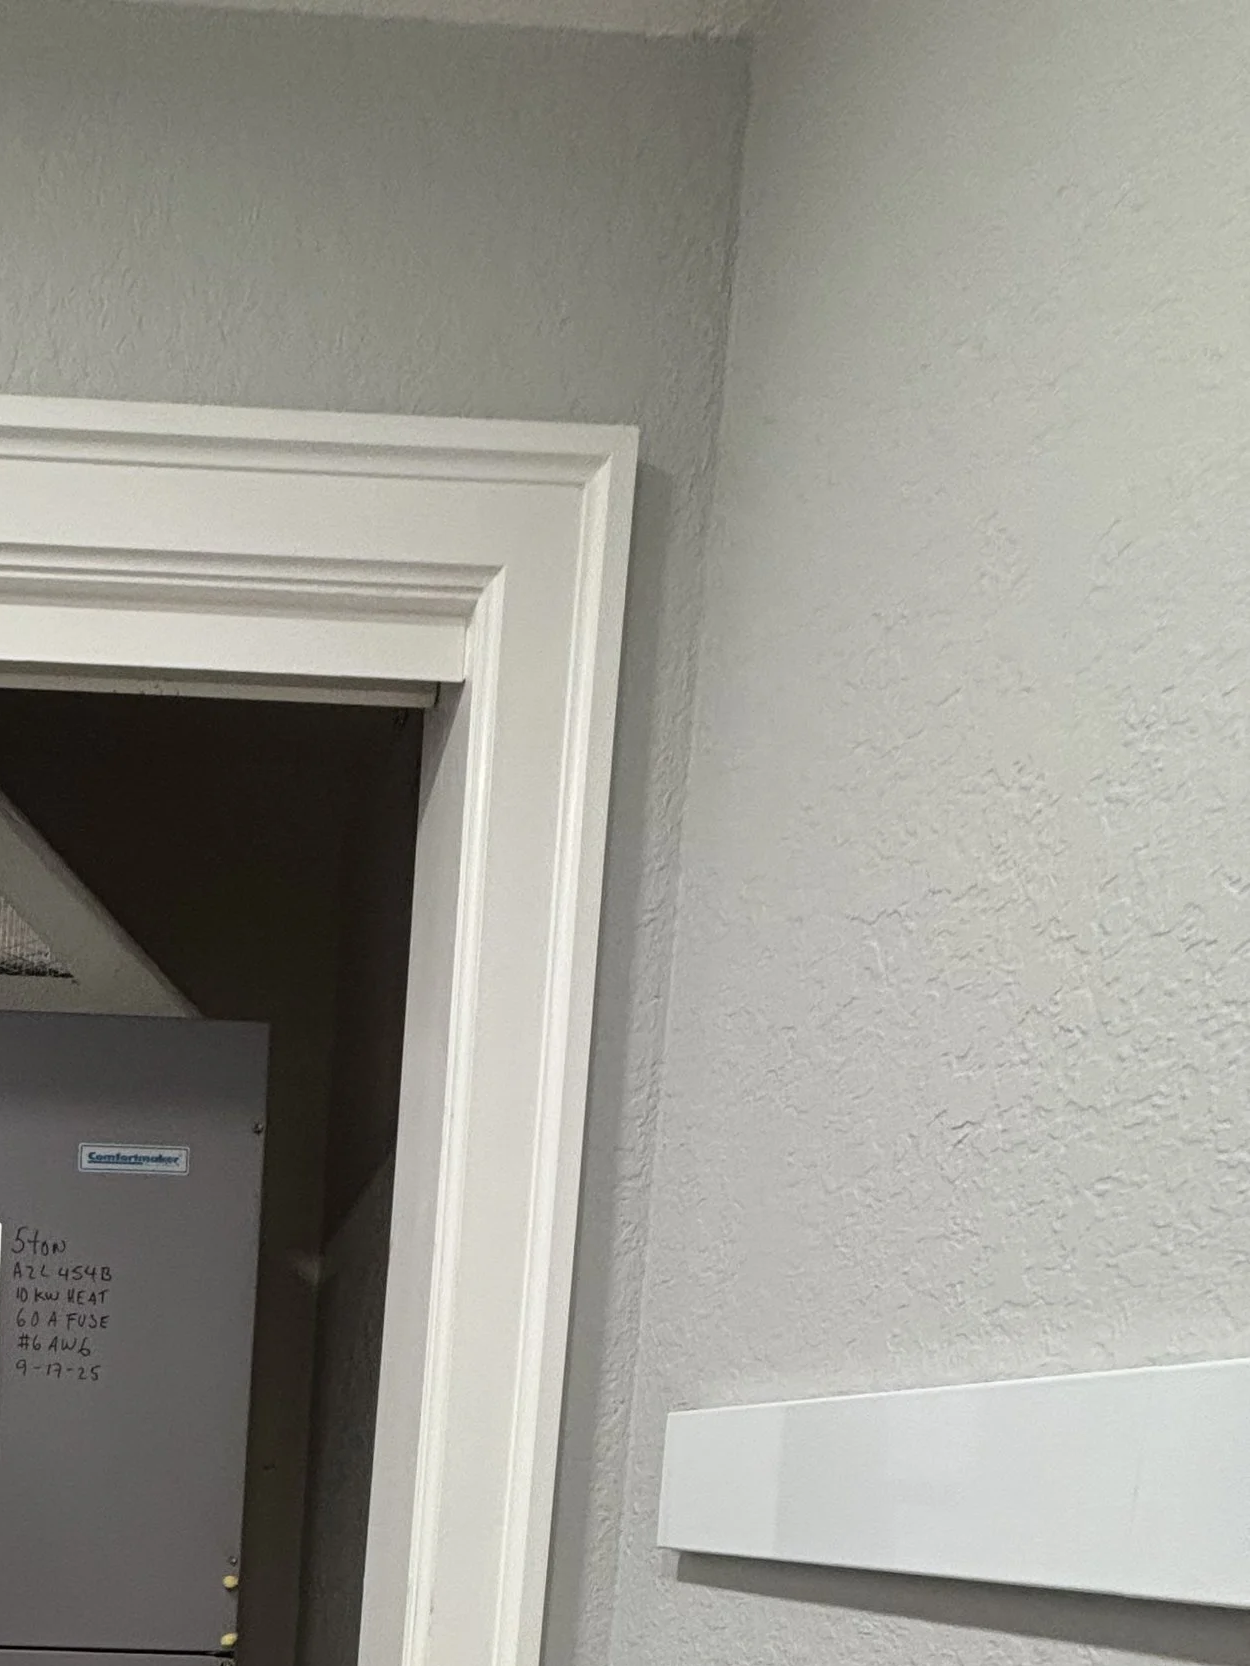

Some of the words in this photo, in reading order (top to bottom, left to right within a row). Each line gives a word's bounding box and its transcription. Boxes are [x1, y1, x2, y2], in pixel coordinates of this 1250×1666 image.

[88, 1151, 180, 1165] Comfortmaker
[58, 1266, 113, 1282] 454B
[16, 1287, 29, 1303] 10
[67, 1288, 110, 1305] HEAT
[66, 1312, 110, 1331] FUSE
